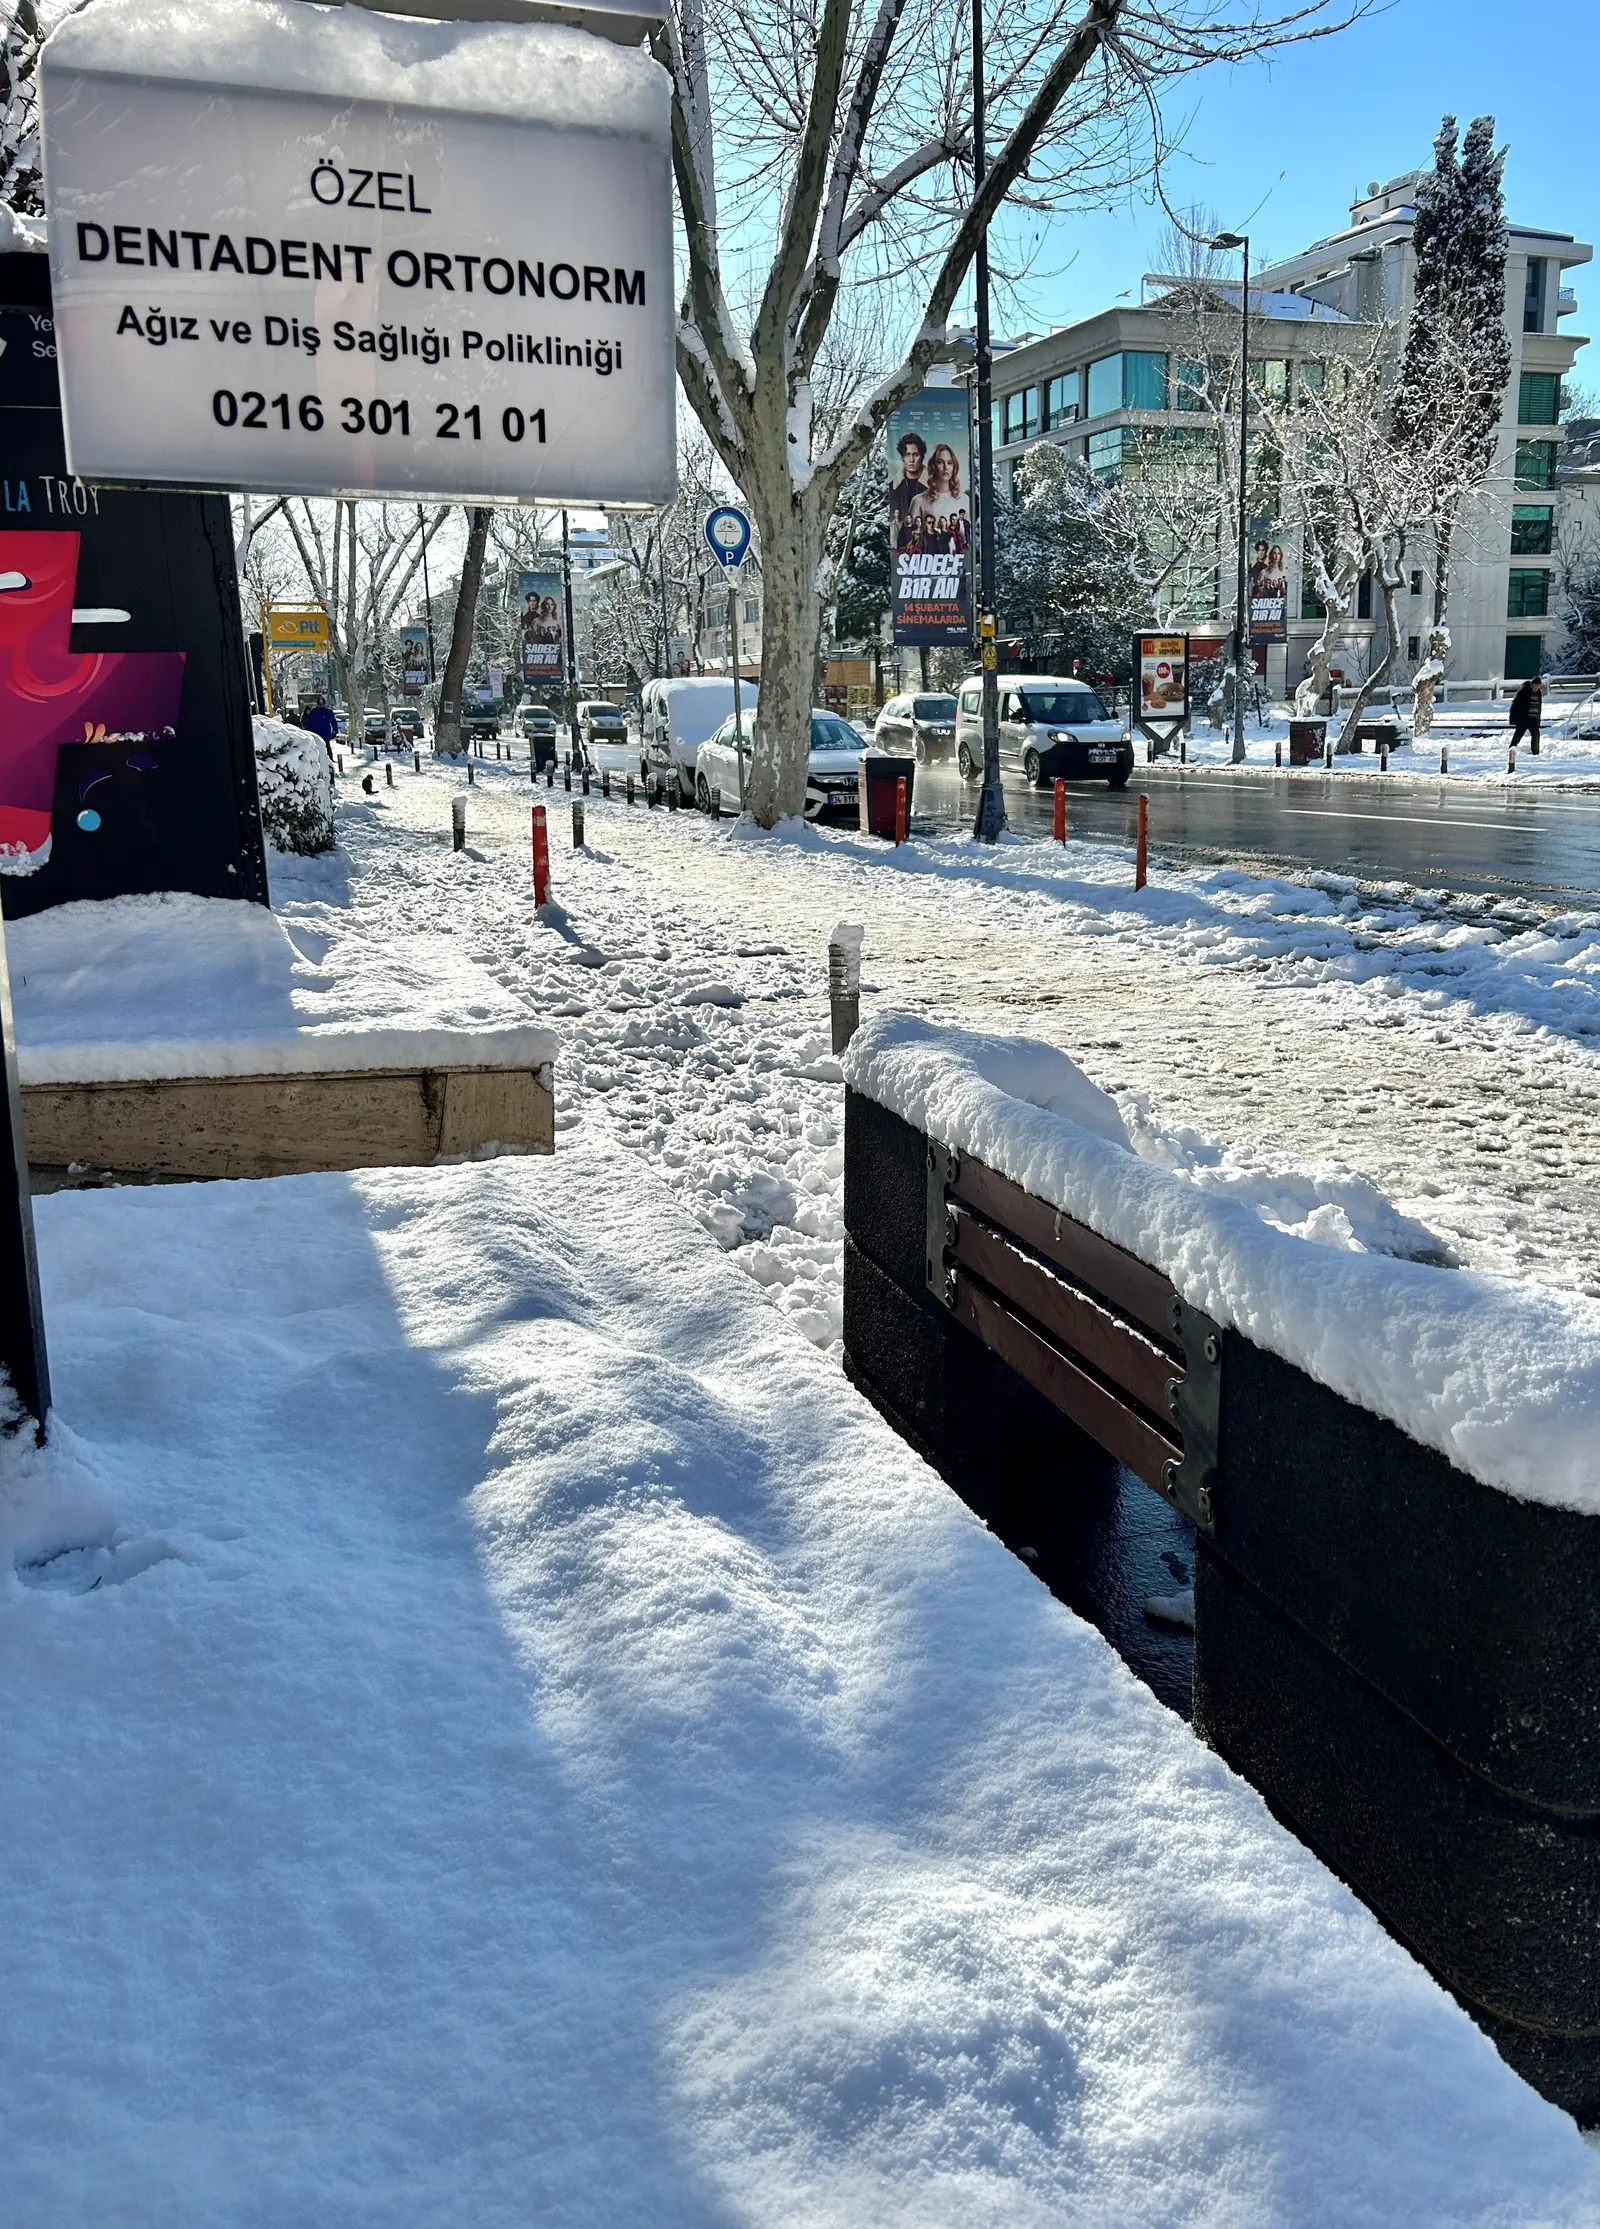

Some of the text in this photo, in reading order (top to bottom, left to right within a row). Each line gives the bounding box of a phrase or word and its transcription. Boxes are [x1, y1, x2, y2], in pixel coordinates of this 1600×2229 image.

[310, 158, 432, 214] ÖZEL
[76, 221, 646, 306] DENTADENT ORTONORM
[116, 305, 623, 376] Ağız ve Diş Sağlığı Polikliniği
[212, 389, 547, 444] 0216 301 21 01
[725, 550, 735, 564] P
[896, 553, 965, 576] SADECE
[932, 577, 960, 599] AN
[896, 612, 966, 625] SİNEMALARDA
[903, 603, 914, 612] 14
